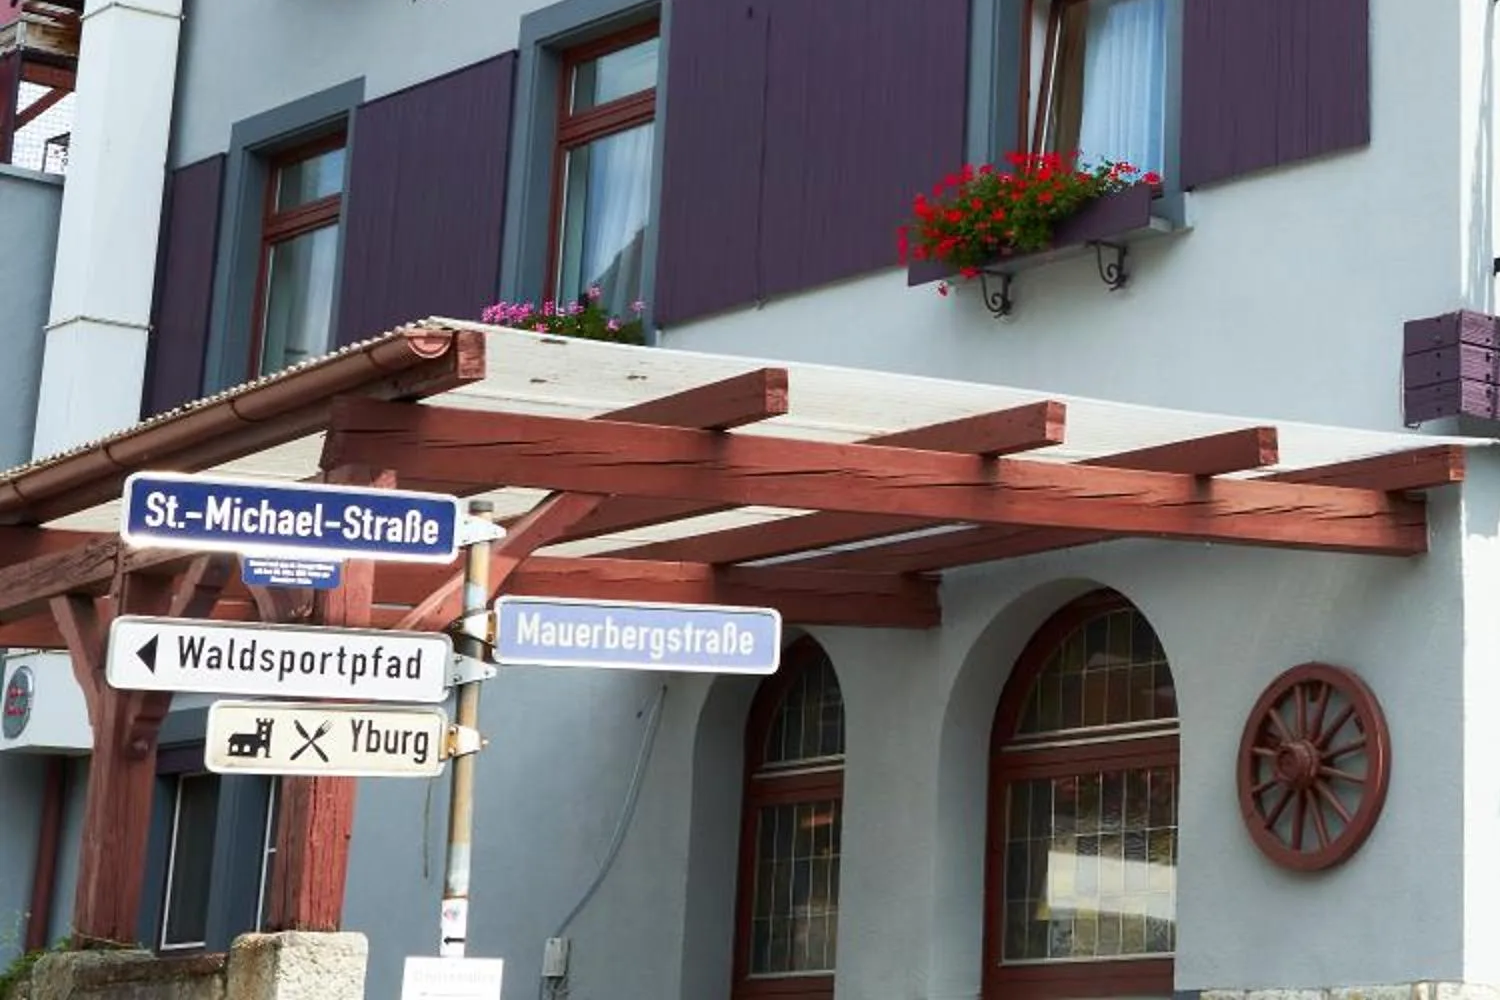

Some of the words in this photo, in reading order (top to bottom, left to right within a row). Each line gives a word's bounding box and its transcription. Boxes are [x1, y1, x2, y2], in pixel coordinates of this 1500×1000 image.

[145, 491, 439, 545] St.-Michael-Straße
[517, 613, 753, 658] Mauerbergstraße
[178, 636, 422, 683] Waldsportpfad
[350, 720, 430, 764] Yburg
